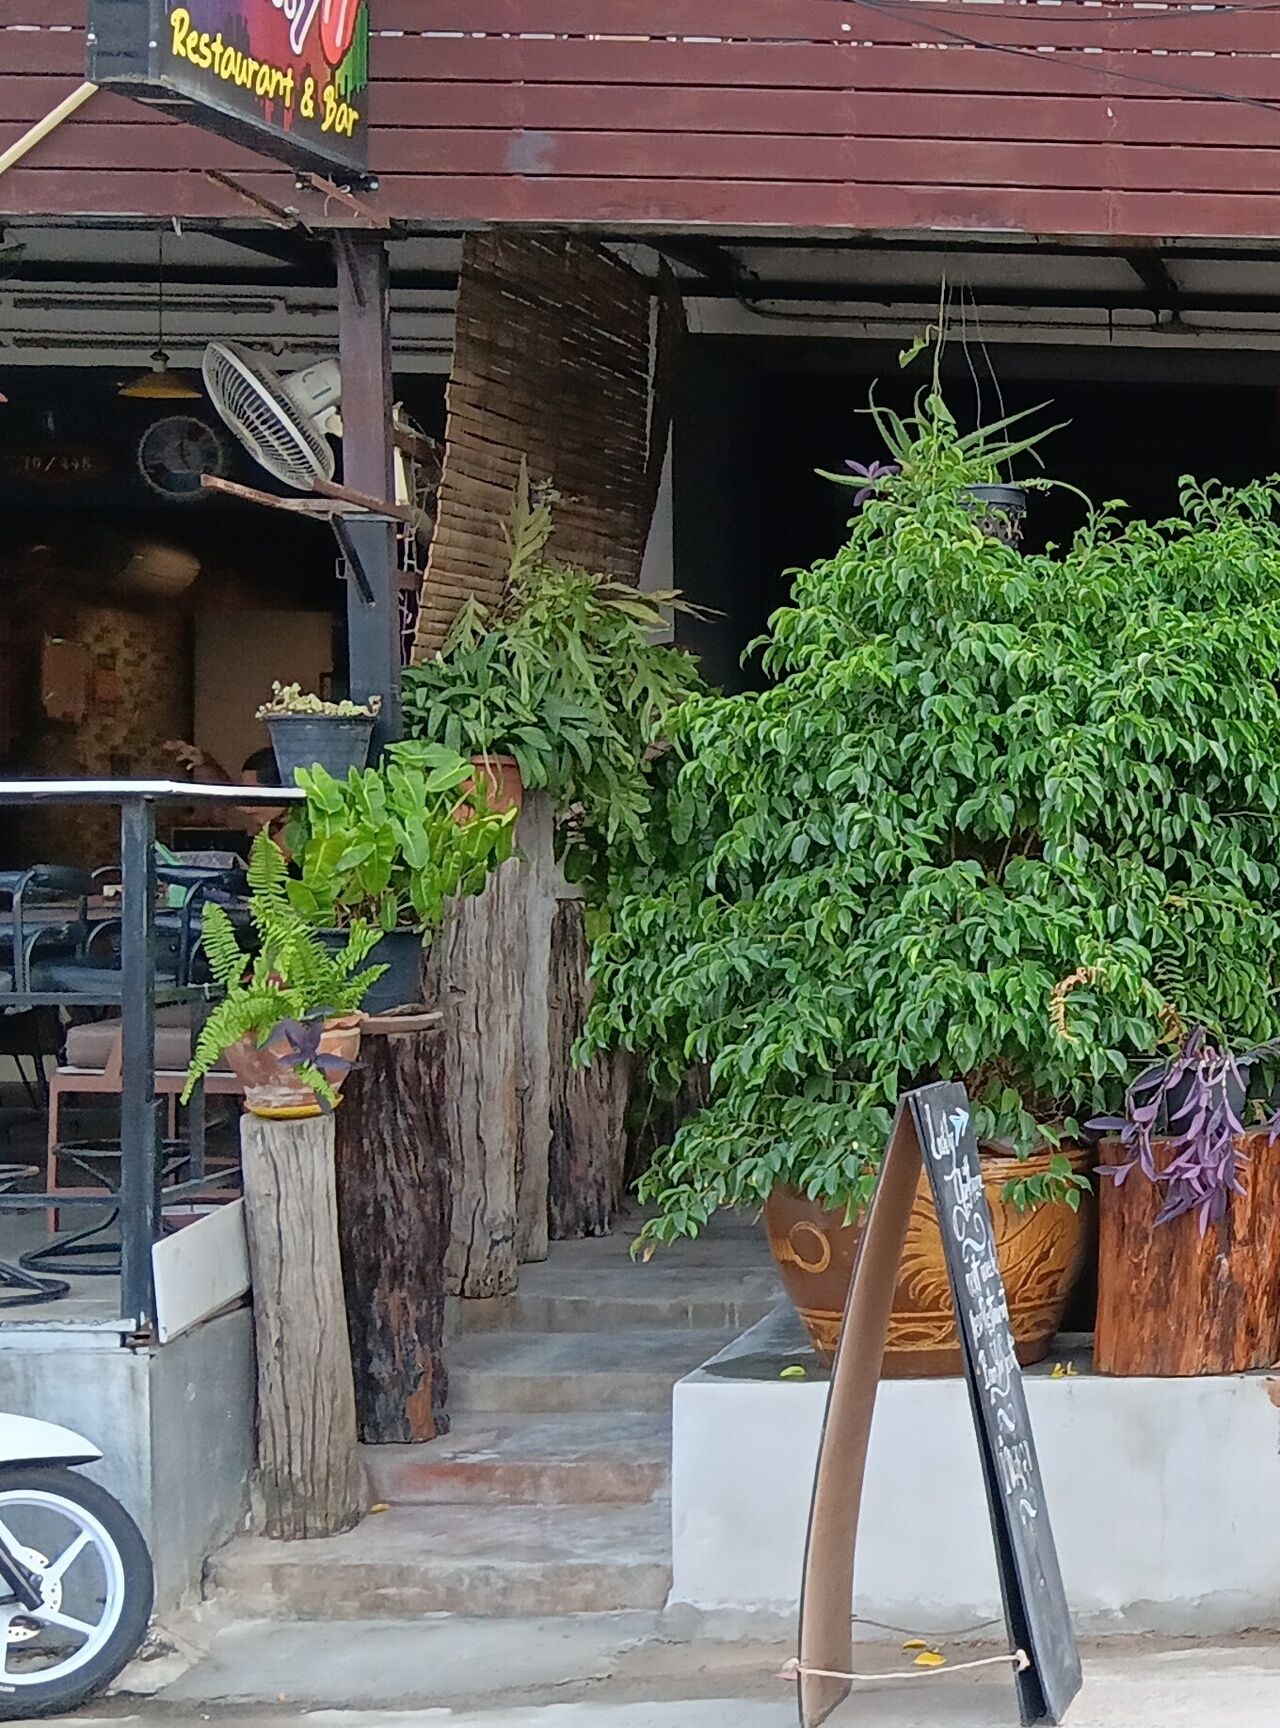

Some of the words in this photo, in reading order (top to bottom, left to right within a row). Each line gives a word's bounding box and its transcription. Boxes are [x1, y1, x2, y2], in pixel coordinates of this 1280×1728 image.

[170, 7, 294, 107] Restaurant
[300, 77, 314, 118] &
[321, 84, 359, 137] Bar
